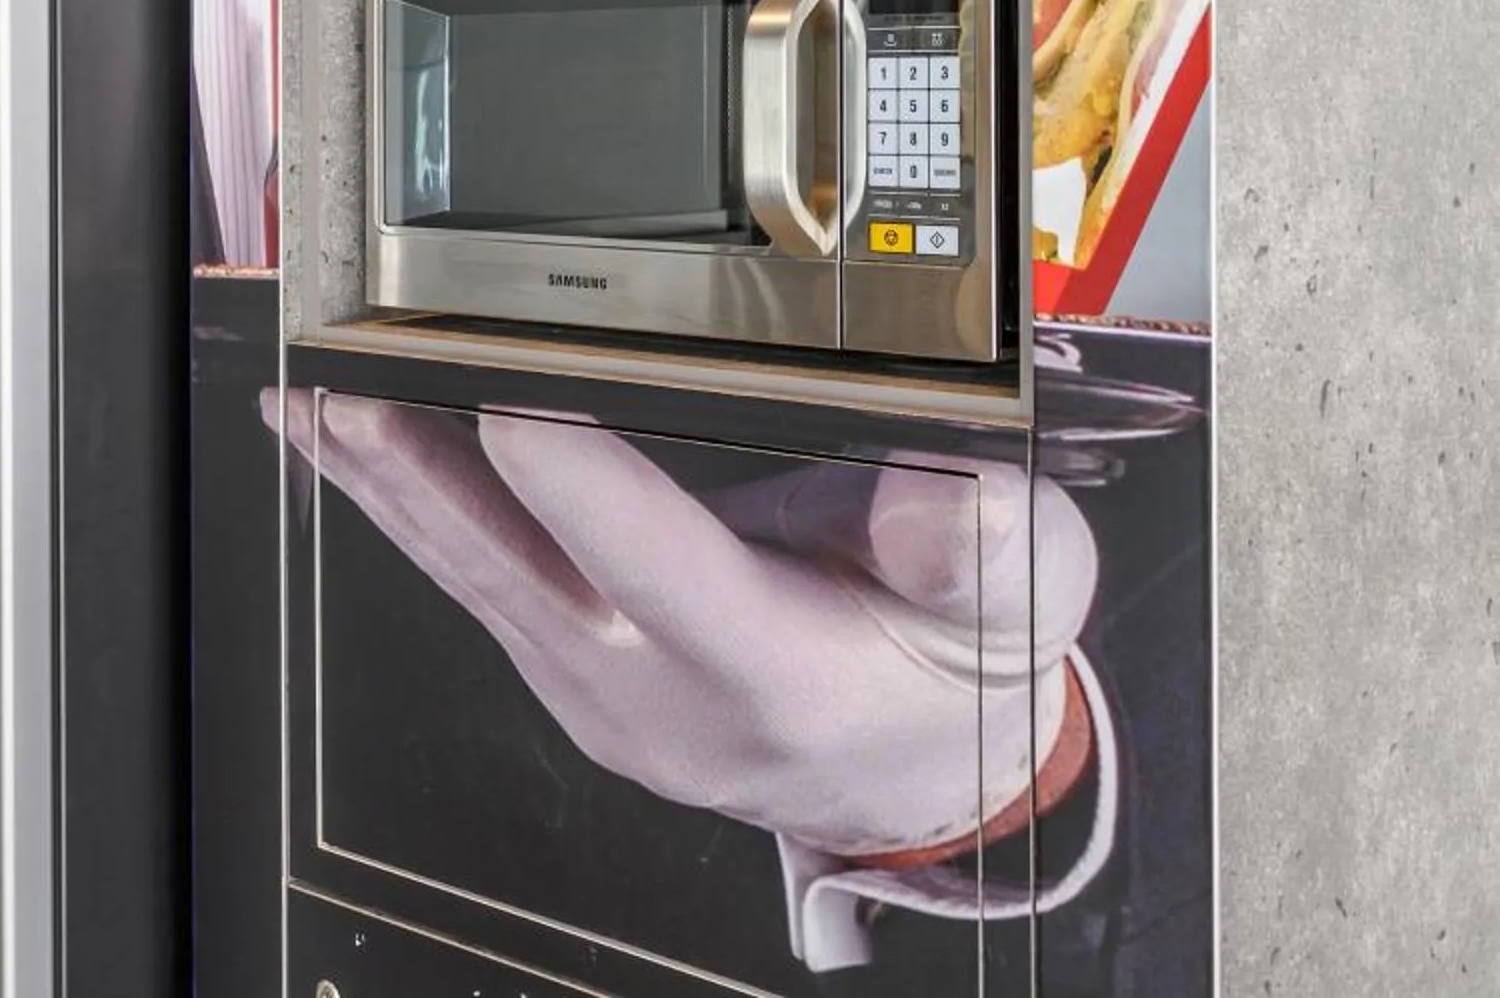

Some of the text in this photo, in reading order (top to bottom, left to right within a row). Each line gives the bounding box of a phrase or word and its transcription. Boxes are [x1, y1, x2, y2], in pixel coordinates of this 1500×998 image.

[880, 65, 949, 81] 1 2 3
[879, 99, 949, 113] 4 5 6
[879, 130, 887, 145] 7
[941, 132, 949, 147] 9
[547, 273, 607, 290] SAMSUNG
